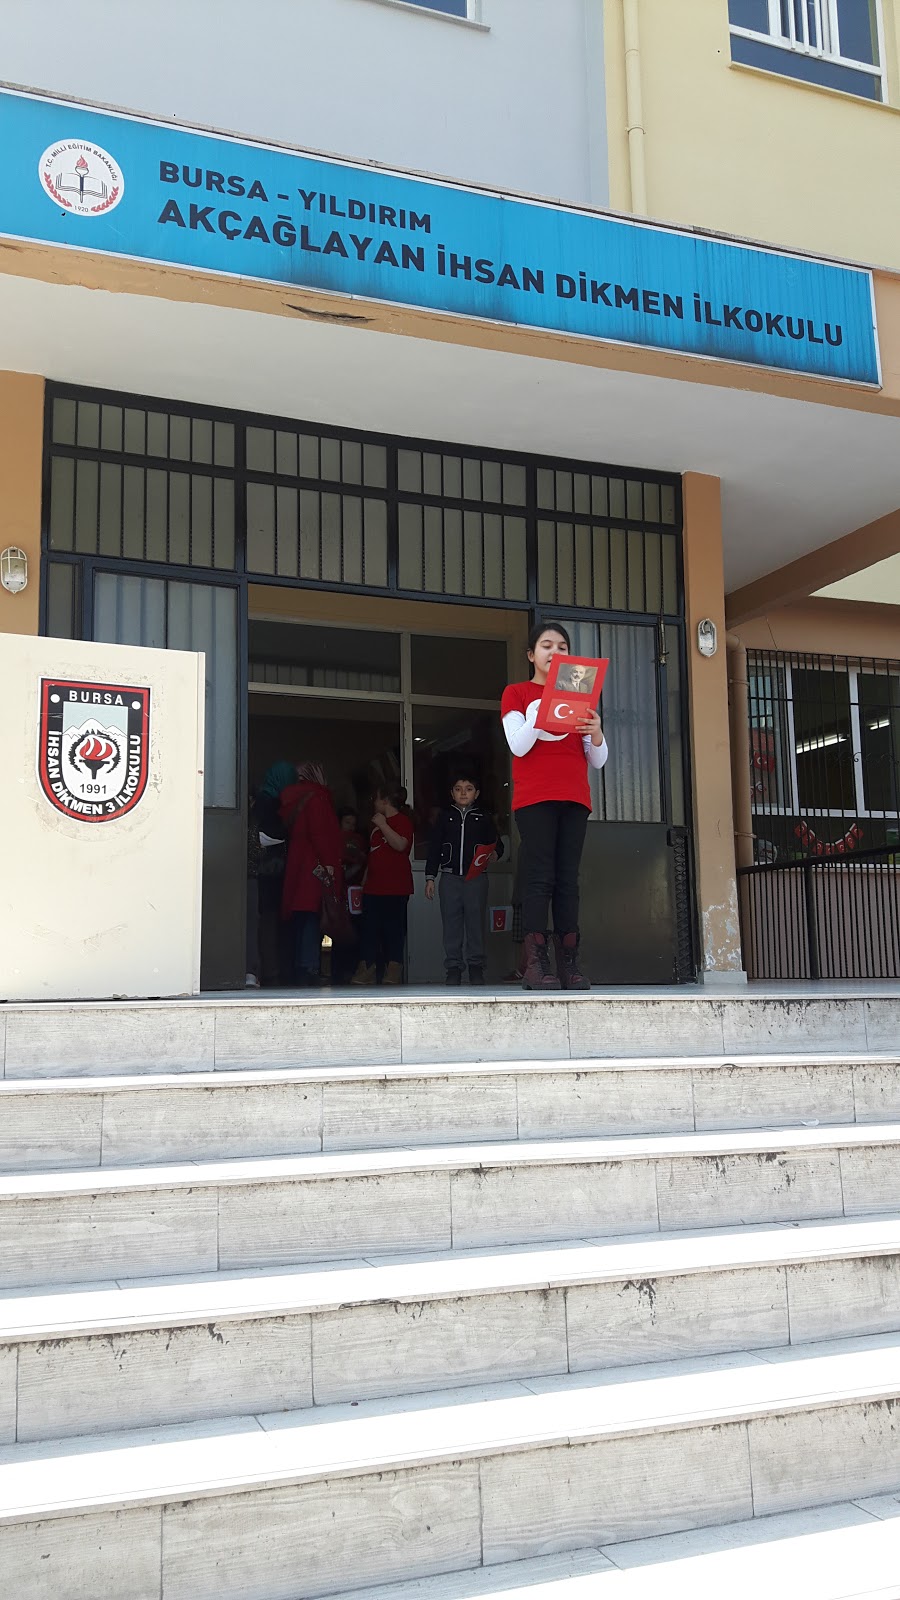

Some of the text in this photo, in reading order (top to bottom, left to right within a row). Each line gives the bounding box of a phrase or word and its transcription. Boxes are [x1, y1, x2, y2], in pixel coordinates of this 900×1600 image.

[67, 143, 92, 153] EĞİTİM
[159, 160, 269, 202] BURSA
[298, 188, 431, 234] YILDIRIM
[74, 205, 89, 213] 1920
[157, 199, 843, 347] AKÇAĞLAYAN İHSAN DİKMEN İLKOKULU
[69, 690, 124, 706] BURSA
[79, 783, 107, 795] 1991
[105, 801, 116, 813] 3
